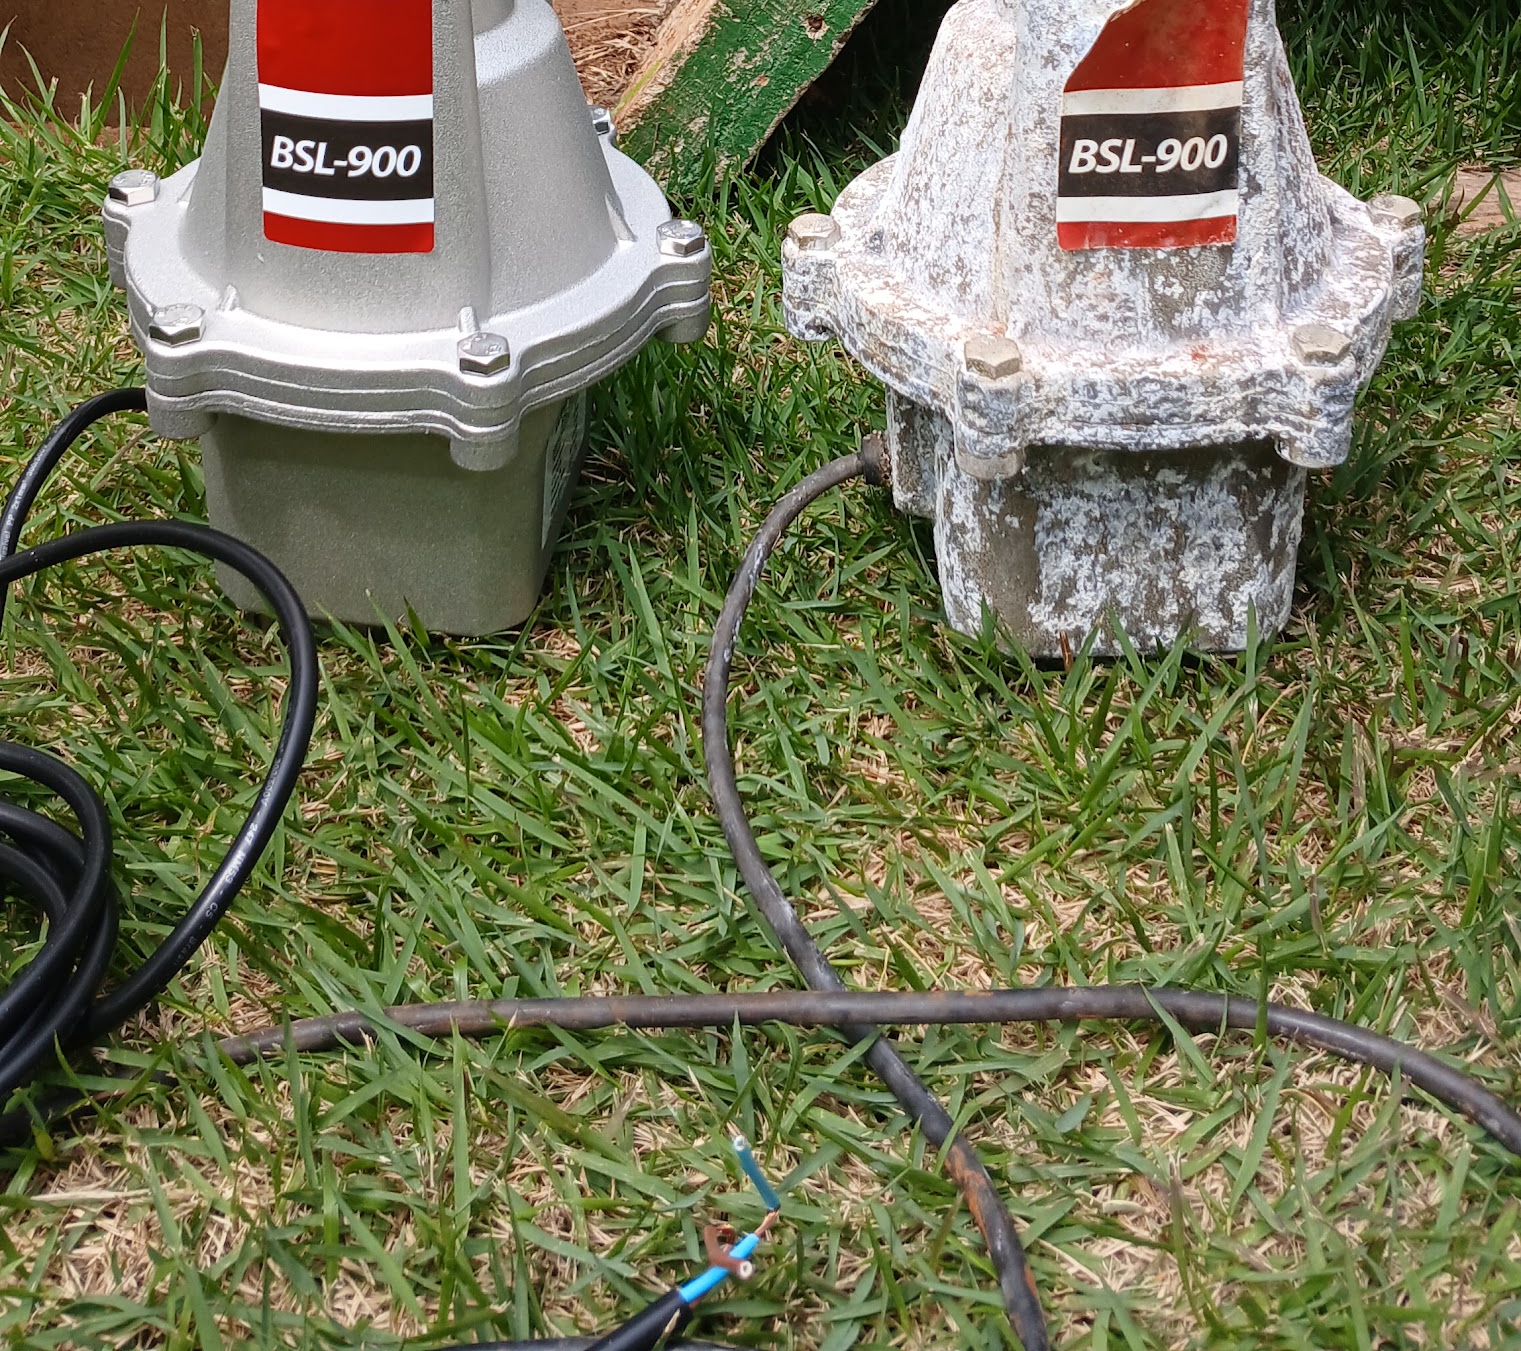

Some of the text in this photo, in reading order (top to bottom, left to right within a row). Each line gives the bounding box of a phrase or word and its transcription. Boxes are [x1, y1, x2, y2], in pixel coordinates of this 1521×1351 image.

[270, 135, 422, 178] BSL-900
[1068, 133, 1228, 174] BSL-900
[244, 822, 258, 845] 247
